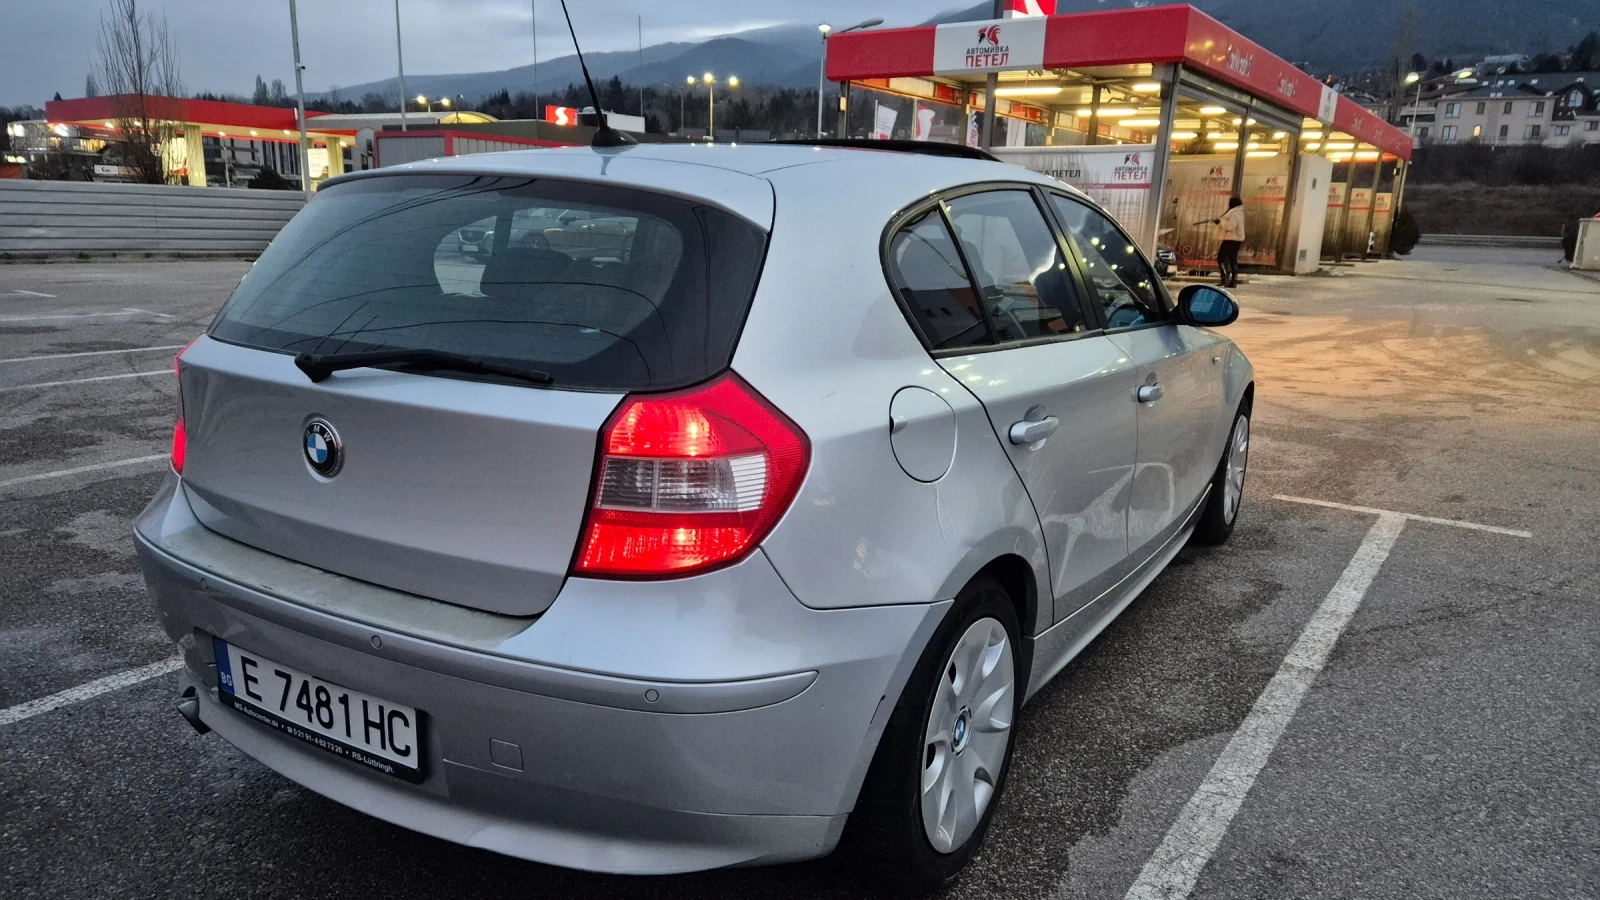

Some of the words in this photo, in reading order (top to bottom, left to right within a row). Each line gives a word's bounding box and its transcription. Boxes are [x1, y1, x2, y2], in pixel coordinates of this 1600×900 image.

[965, 45, 1009, 55] АВТОМИВКА
[965, 53, 1009, 68] ПЕТЕЛ
[1052, 169, 1081, 178] ПЕТЕЛ
[1114, 171, 1147, 180] ПЕТЕЛ
[305, 425, 332, 442] BMW
[220, 672, 233, 687] BG
[241, 655, 263, 702] E
[274, 668, 352, 738] 7481
[362, 699, 411, 758] HC
[234, 701, 279, 728] MS-Autocenter.de
